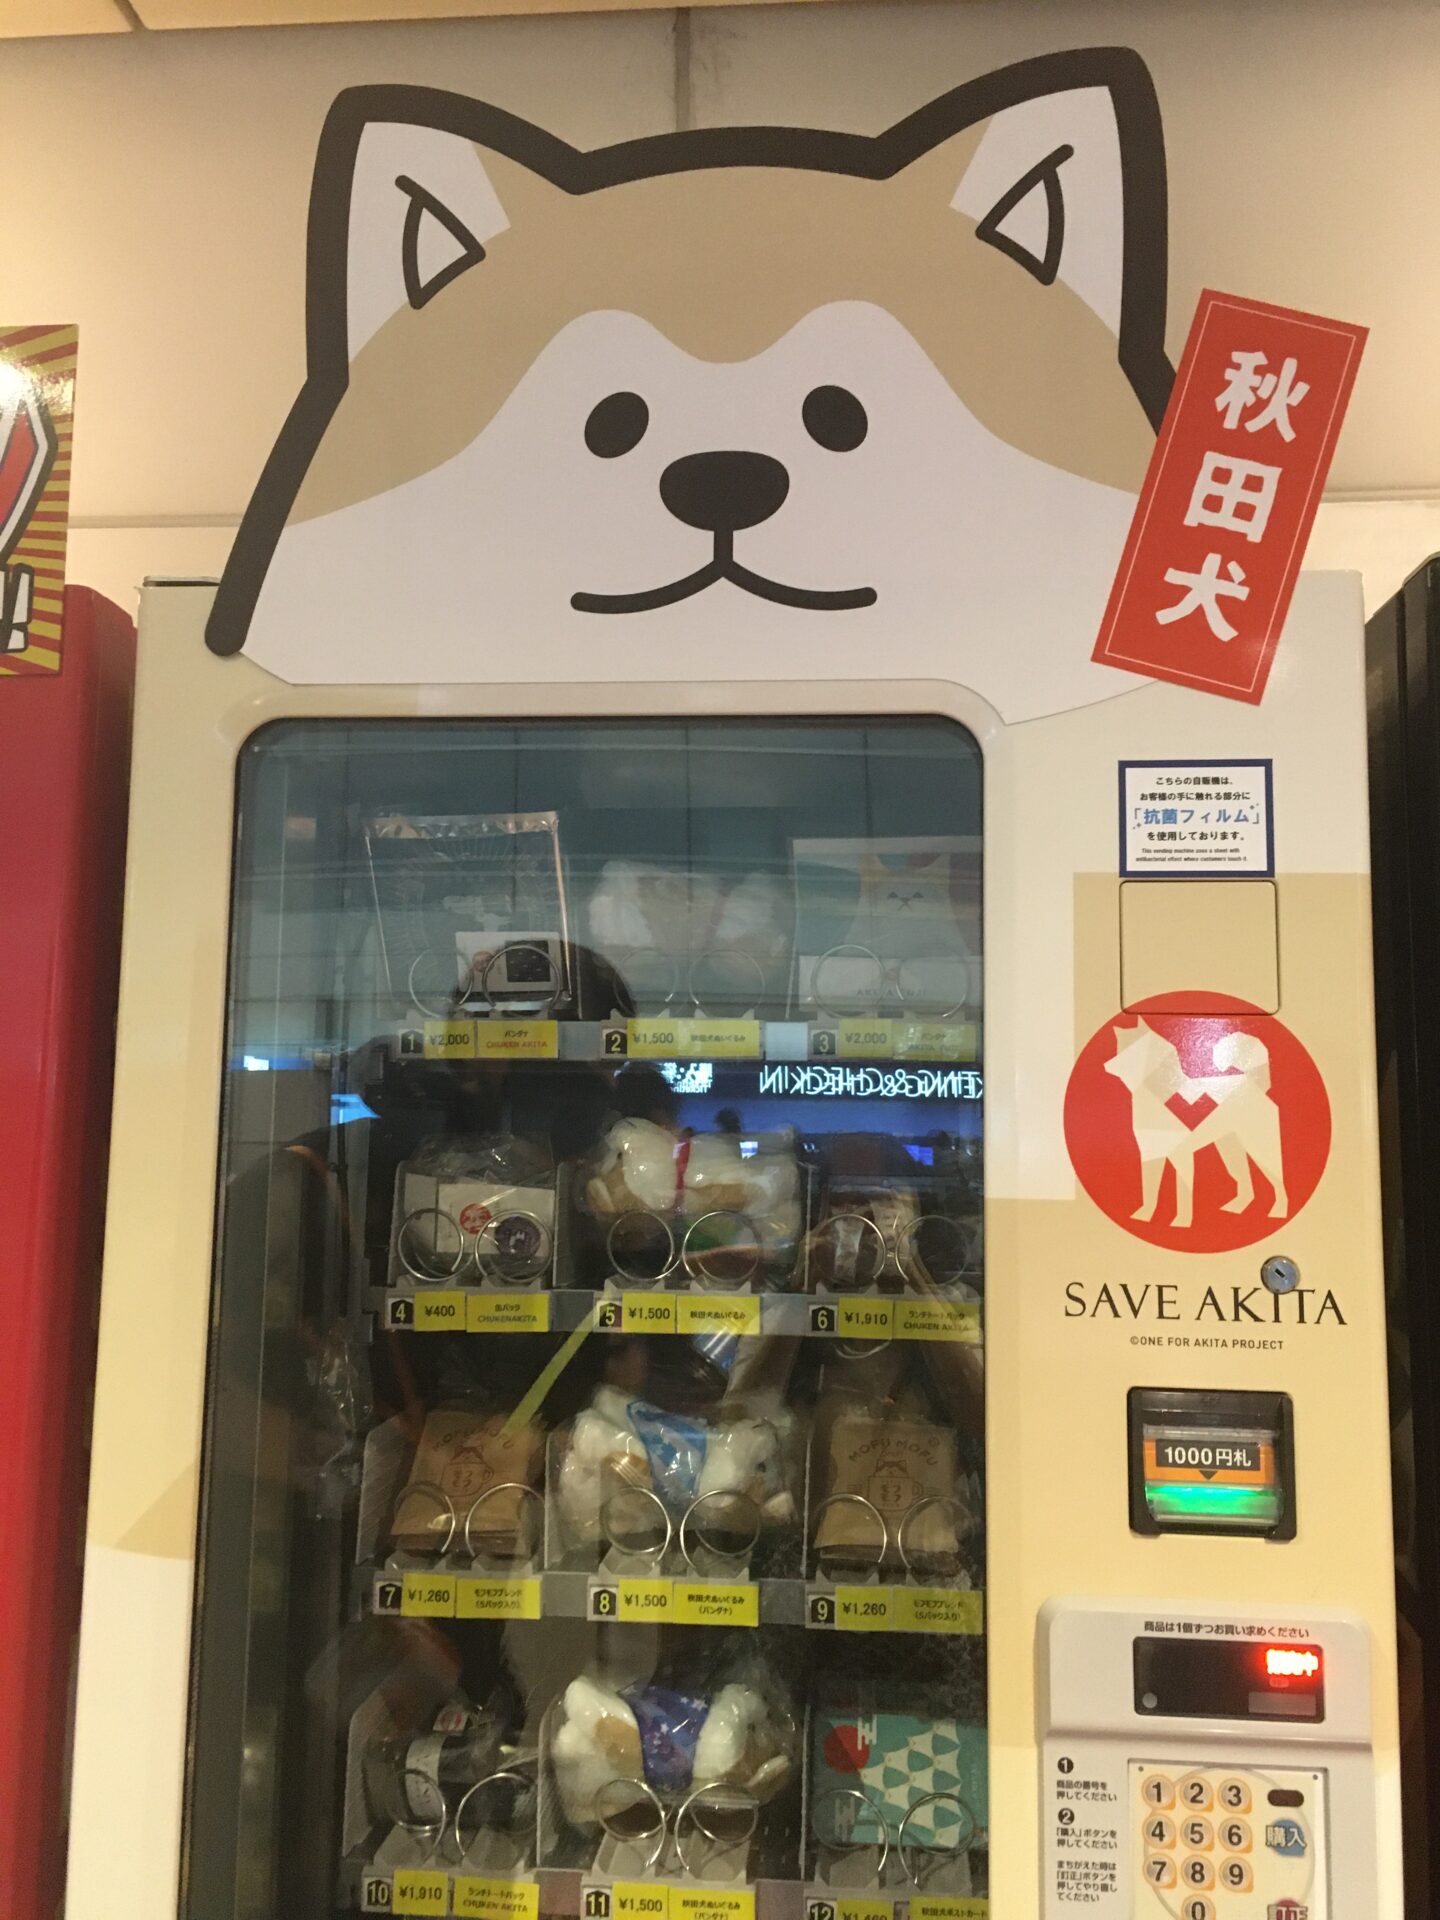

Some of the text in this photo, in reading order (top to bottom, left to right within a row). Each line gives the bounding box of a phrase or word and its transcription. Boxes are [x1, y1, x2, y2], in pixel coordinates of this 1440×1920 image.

[1155, 351, 1310, 642] 秋田犬
[1134, 808, 1260, 825] 「抗菌フィルム」
[1147, 831, 1245, 841] を使用しております。
[408, 1033, 415, 1051] 1
[429, 1034, 470, 1046] ¥2,000
[611, 1034, 621, 1052] 2
[633, 1033, 674, 1044] ¥1,500
[819, 1036, 829, 1052] 3
[845, 1032, 887, 1044] ¥2,000
[425, 1305, 455, 1317] ¥400
[1065, 1281, 1348, 1325] SAVE AKITA
[396, 1302, 406, 1323] 4
[605, 1305, 615, 1325] 5
[629, 1307, 671, 1320] ¥1,500
[818, 1310, 828, 1329] 6
[844, 1312, 888, 1326] ¥1,910
[1168, 1337, 1190, 1347] FOR
[1194, 1338, 1228, 1349] AKITA
[1232, 1339, 1284, 1350] PROJECT
[1164, 1446, 1252, 1467] 1000円札
[385, 1587, 396, 1607] 7
[408, 1589, 450, 1603] ¥1,260
[600, 1593, 610, 1613] 8
[624, 1594, 667, 1607] ¥1,500
[818, 1601, 828, 1620] 9
[843, 1603, 887, 1616] ¥1,260
[1144, 1621, 1309, 1638] 商品は1個ずつお買い求めください
[1056, 1791, 1117, 1801] 押してください
[1152, 1782, 1242, 1807] 1 2 3
[1056, 1827, 1117, 1839] 「購入」ボタンを
[1151, 1821, 1242, 1846] 4 5 6
[1265, 1825, 1307, 1848] 購入
[1057, 1838, 1117, 1849] 押してください
[1057, 1860, 1116, 1871] まちがえた時は
[1152, 1861, 1244, 1885] 7 8 9
[1057, 1870, 1116, 1882] 「訂正」ボタンを
[369, 1884, 388, 1904] 10
[399, 1886, 442, 1901] ¥1,910
[1057, 1881, 1117, 1892] 押してやり直し
[588, 1894, 606, 1915] 11
[619, 1898, 662, 1912] ¥1,500
[1057, 1892, 1100, 1902] てください
[1191, 1901, 1206, 1920] 0
